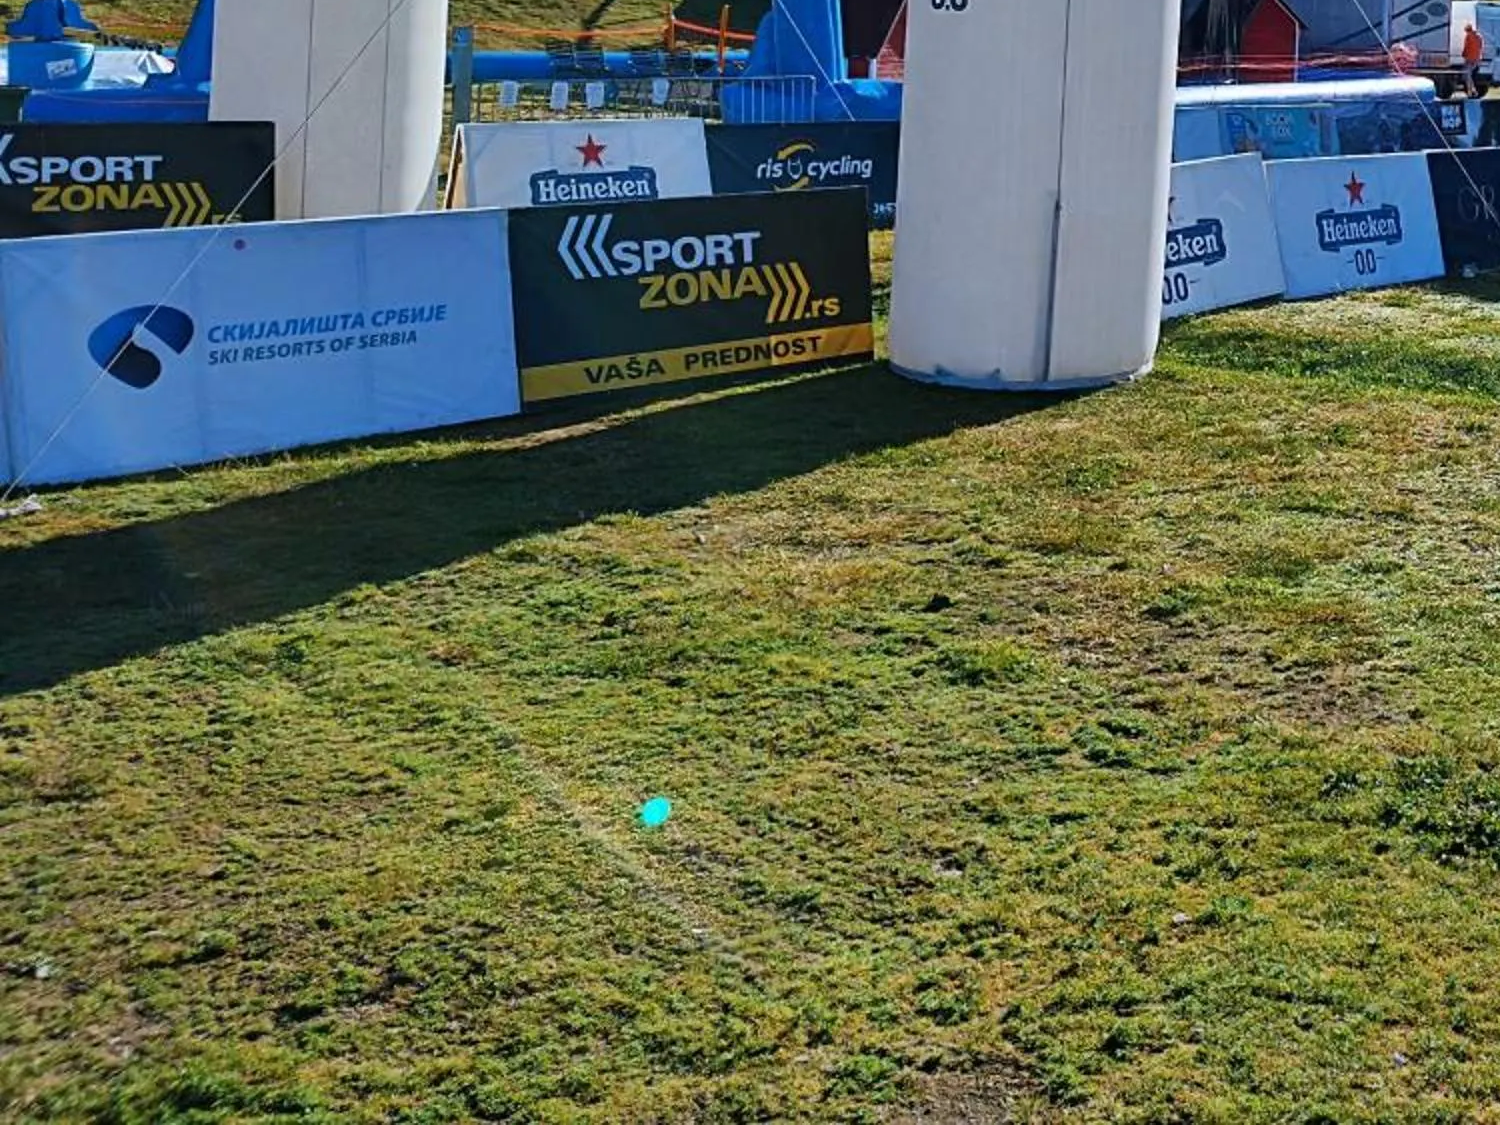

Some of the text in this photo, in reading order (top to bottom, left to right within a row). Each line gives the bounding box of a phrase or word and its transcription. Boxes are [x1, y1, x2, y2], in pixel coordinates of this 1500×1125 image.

[9, 155, 163, 185] SPORT
[756, 155, 873, 180] ris cycling
[31, 183, 166, 213] ZONA
[537, 176, 651, 203] Heineken
[1323, 215, 1398, 243] Heineken
[611, 231, 761, 276] SPORT
[1166, 233, 1220, 261] eken
[1355, 248, 1377, 275] 0.0
[638, 266, 769, 309] ZONA
[207, 303, 447, 344] СКИЈАЛИШТА СРБИЈЕ
[208, 329, 418, 366] SKI RESORTS OF SERBIA
[584, 336, 822, 384] VAŠA PREDNOST
